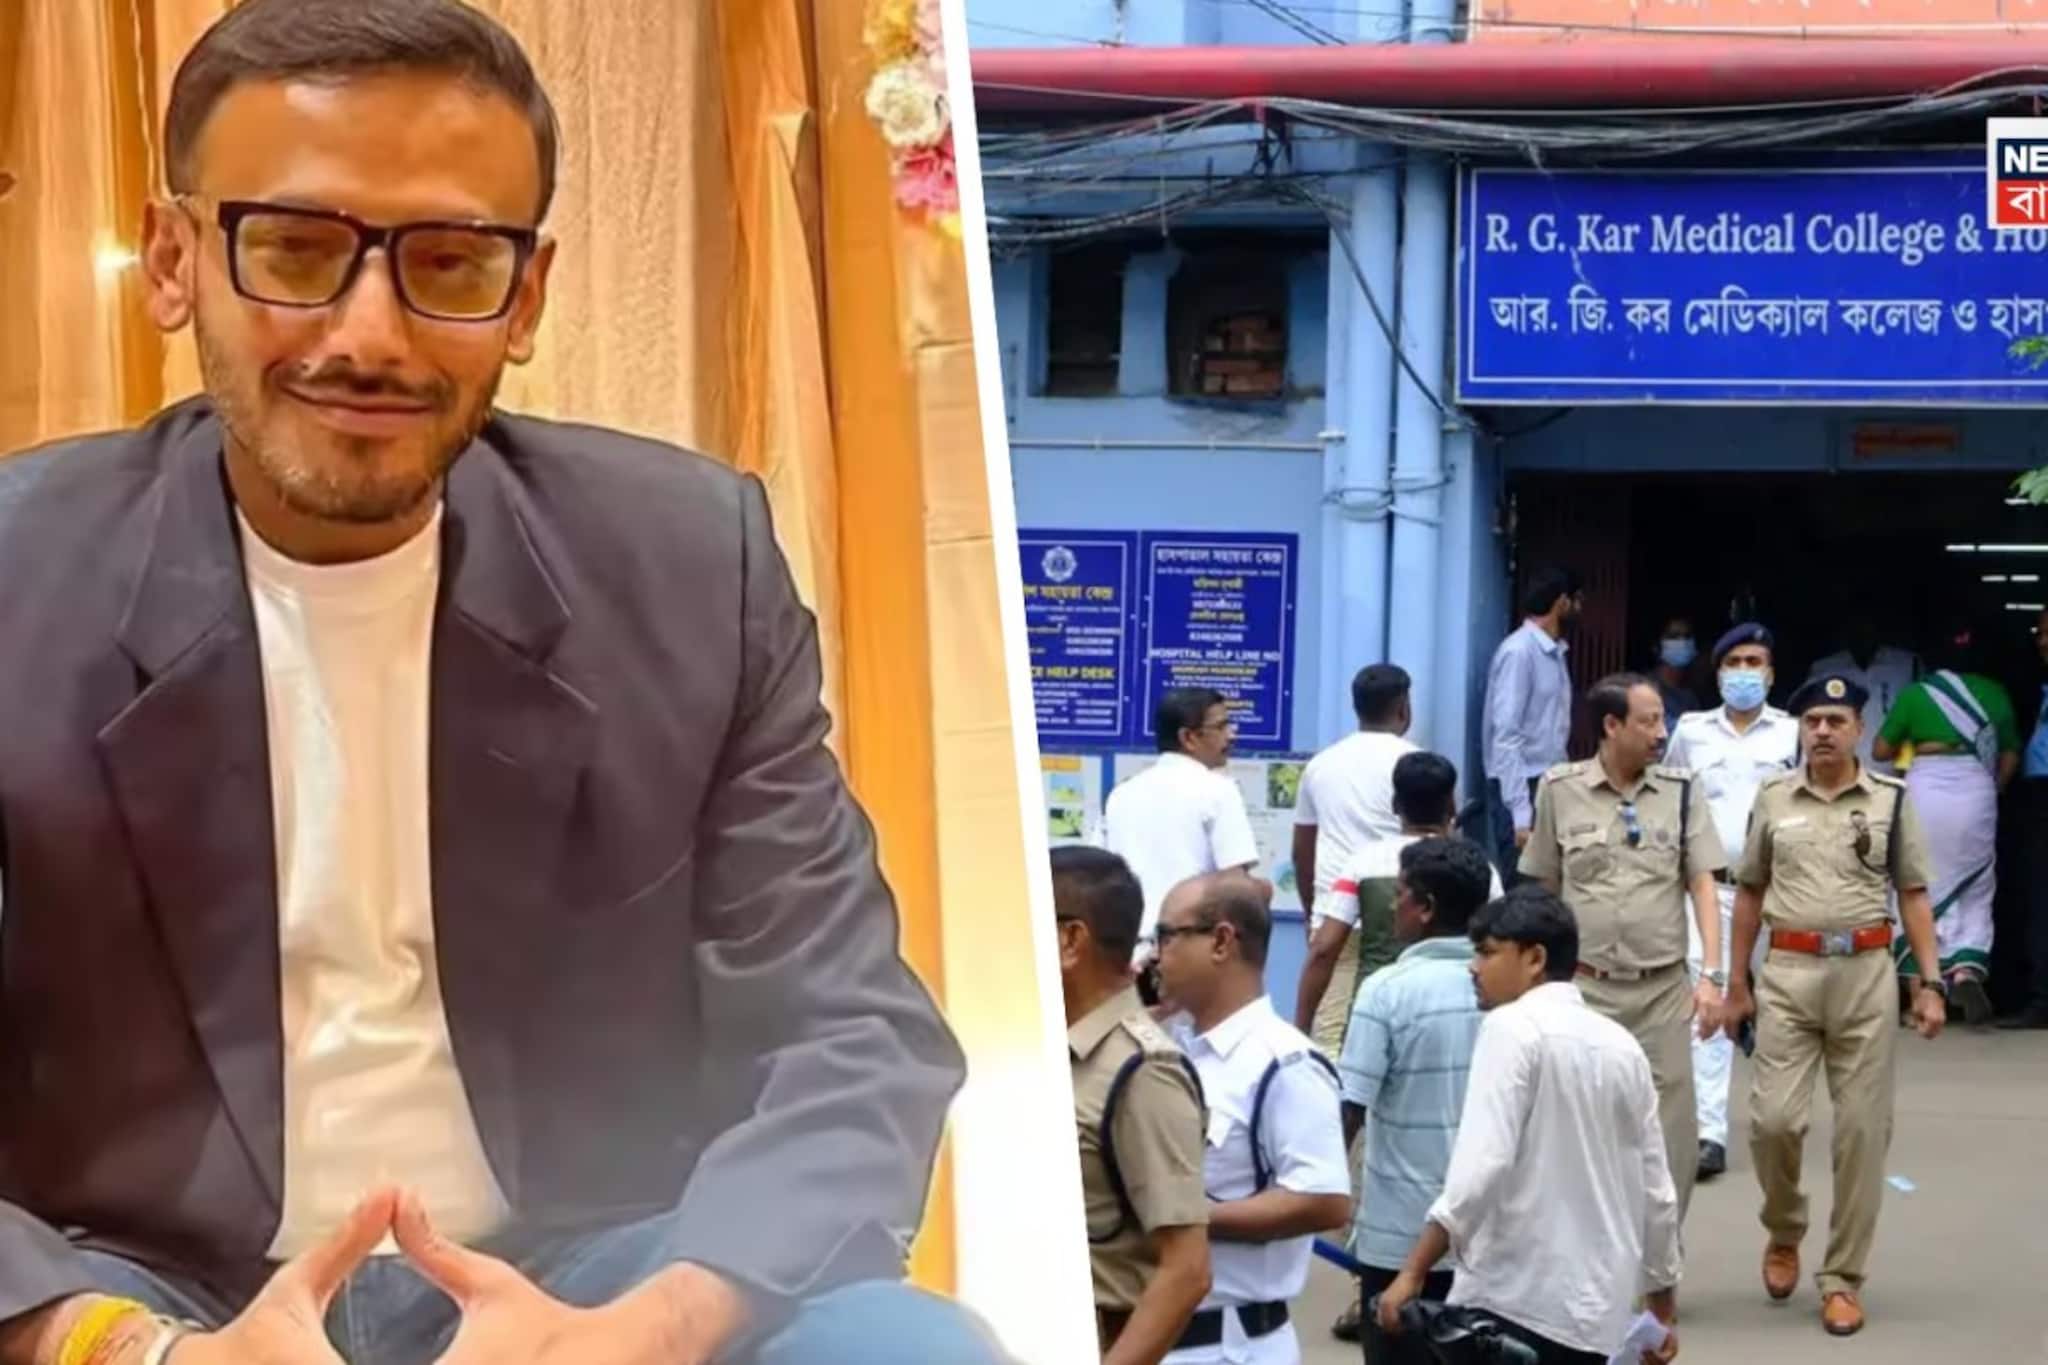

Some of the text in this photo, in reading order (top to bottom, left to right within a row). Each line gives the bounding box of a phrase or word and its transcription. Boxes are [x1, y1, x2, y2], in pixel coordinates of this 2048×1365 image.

[1485, 214, 1518, 253] R.
[1528, 213, 1566, 253] G.
[1577, 213, 1640, 253] Kar
[1650, 213, 1794, 254] Medical
[1804, 212, 1945, 266] College
[1954, 214, 1983, 253] &
[1489, 284, 2048, 340] আর. জি. কর মেডিক্যাল কলেজ ও হাস
[1149, 648, 1203, 660] HOSPITAL
[1205, 649, 1233, 660] HELP
[1235, 650, 1261, 661] LINE
[1046, 666, 1079, 679] HELP
[1081, 667, 1115, 679] DESK
